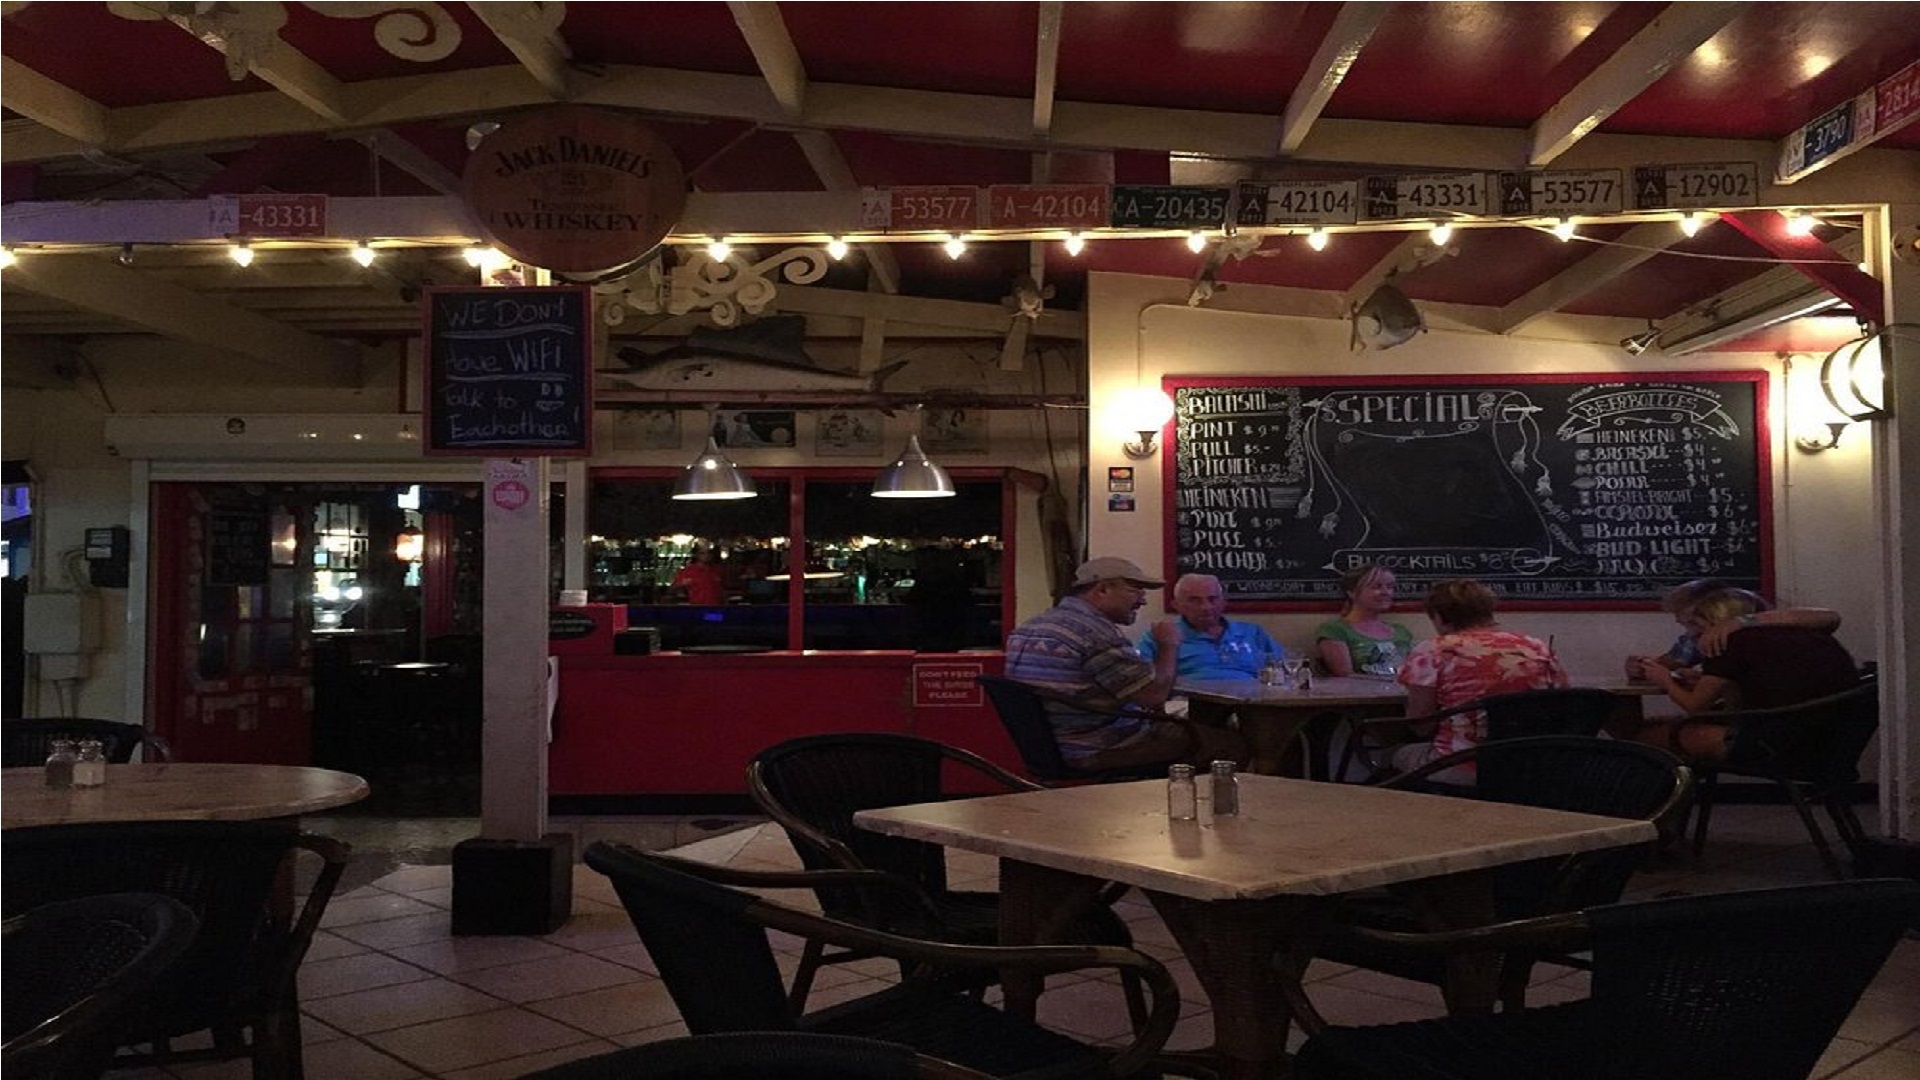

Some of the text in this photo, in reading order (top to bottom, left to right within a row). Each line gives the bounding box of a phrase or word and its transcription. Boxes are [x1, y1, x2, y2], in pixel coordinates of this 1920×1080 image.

[494, 144, 556, 178] JACK
[1377, 184, 1479, 208] A-43331
[1510, 179, 1615, 205] A-53577
[1644, 173, 1750, 198] A-12902
[871, 196, 972, 219] A-53577
[1004, 195, 1099, 219] A-42104
[1126, 196, 1223, 220] A-20435
[1246, 189, 1349, 213] A-42104
[219, 205, 319, 228] A-43331
[501, 212, 643, 231] WHISKEY
[441, 297, 489, 327] WE
[493, 385, 518, 408] to
[1335, 391, 1480, 425] SPECIAL
[1190, 421, 1237, 439] PINT
[1190, 440, 1234, 458] PULL
[1190, 456, 1259, 477] PITCHER
[1594, 460, 1649, 475] CHILL
[1183, 486, 1268, 509] HEINEKEN
[1190, 508, 1238, 528] PINT
[1192, 529, 1246, 549] PULL
[1596, 521, 1718, 539] Budweiser
[1596, 541, 1641, 558] BUD
[1650, 538, 1711, 555] LIGHT
[1192, 549, 1268, 572] PITCHER
